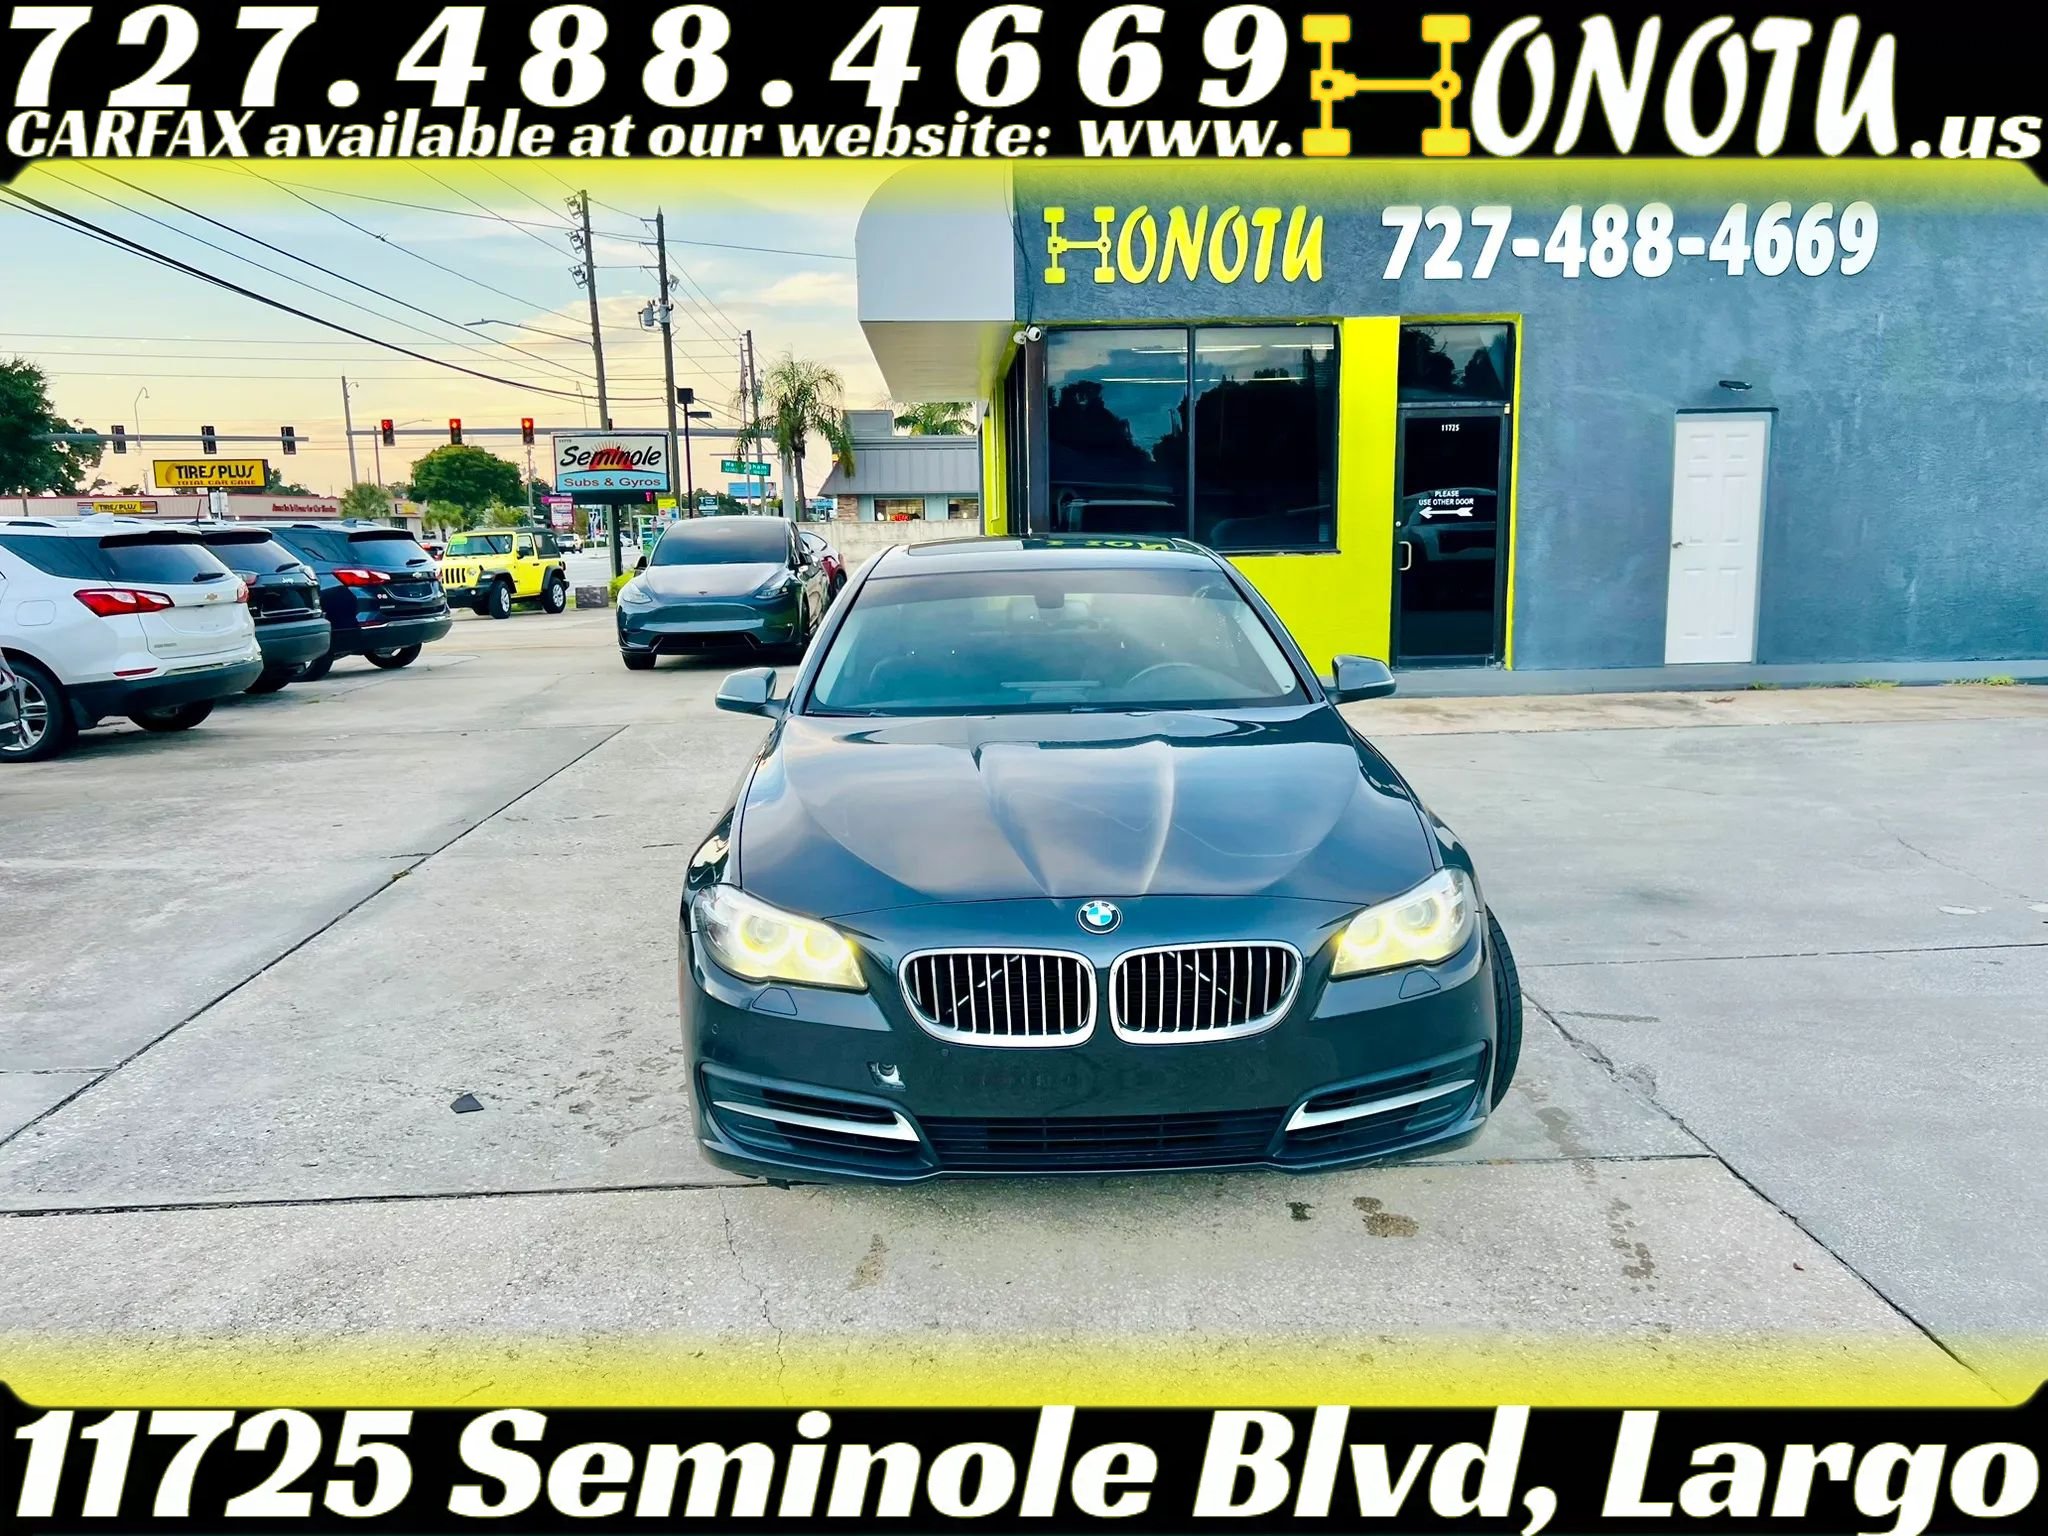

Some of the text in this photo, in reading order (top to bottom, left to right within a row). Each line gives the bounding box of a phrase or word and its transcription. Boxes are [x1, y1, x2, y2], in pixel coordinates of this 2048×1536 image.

[1381, 201, 1879, 280] 727-488-4669
[1441, 423, 1460, 432] 11725
[560, 445, 662, 467] Seminole
[175, 465, 255, 479] TIRES PLUS
[564, 477, 661, 489] Subs & Gyros
[1434, 490, 1460, 498] PLEASE
[1418, 497, 1474, 506] USE OTHER DOOR
